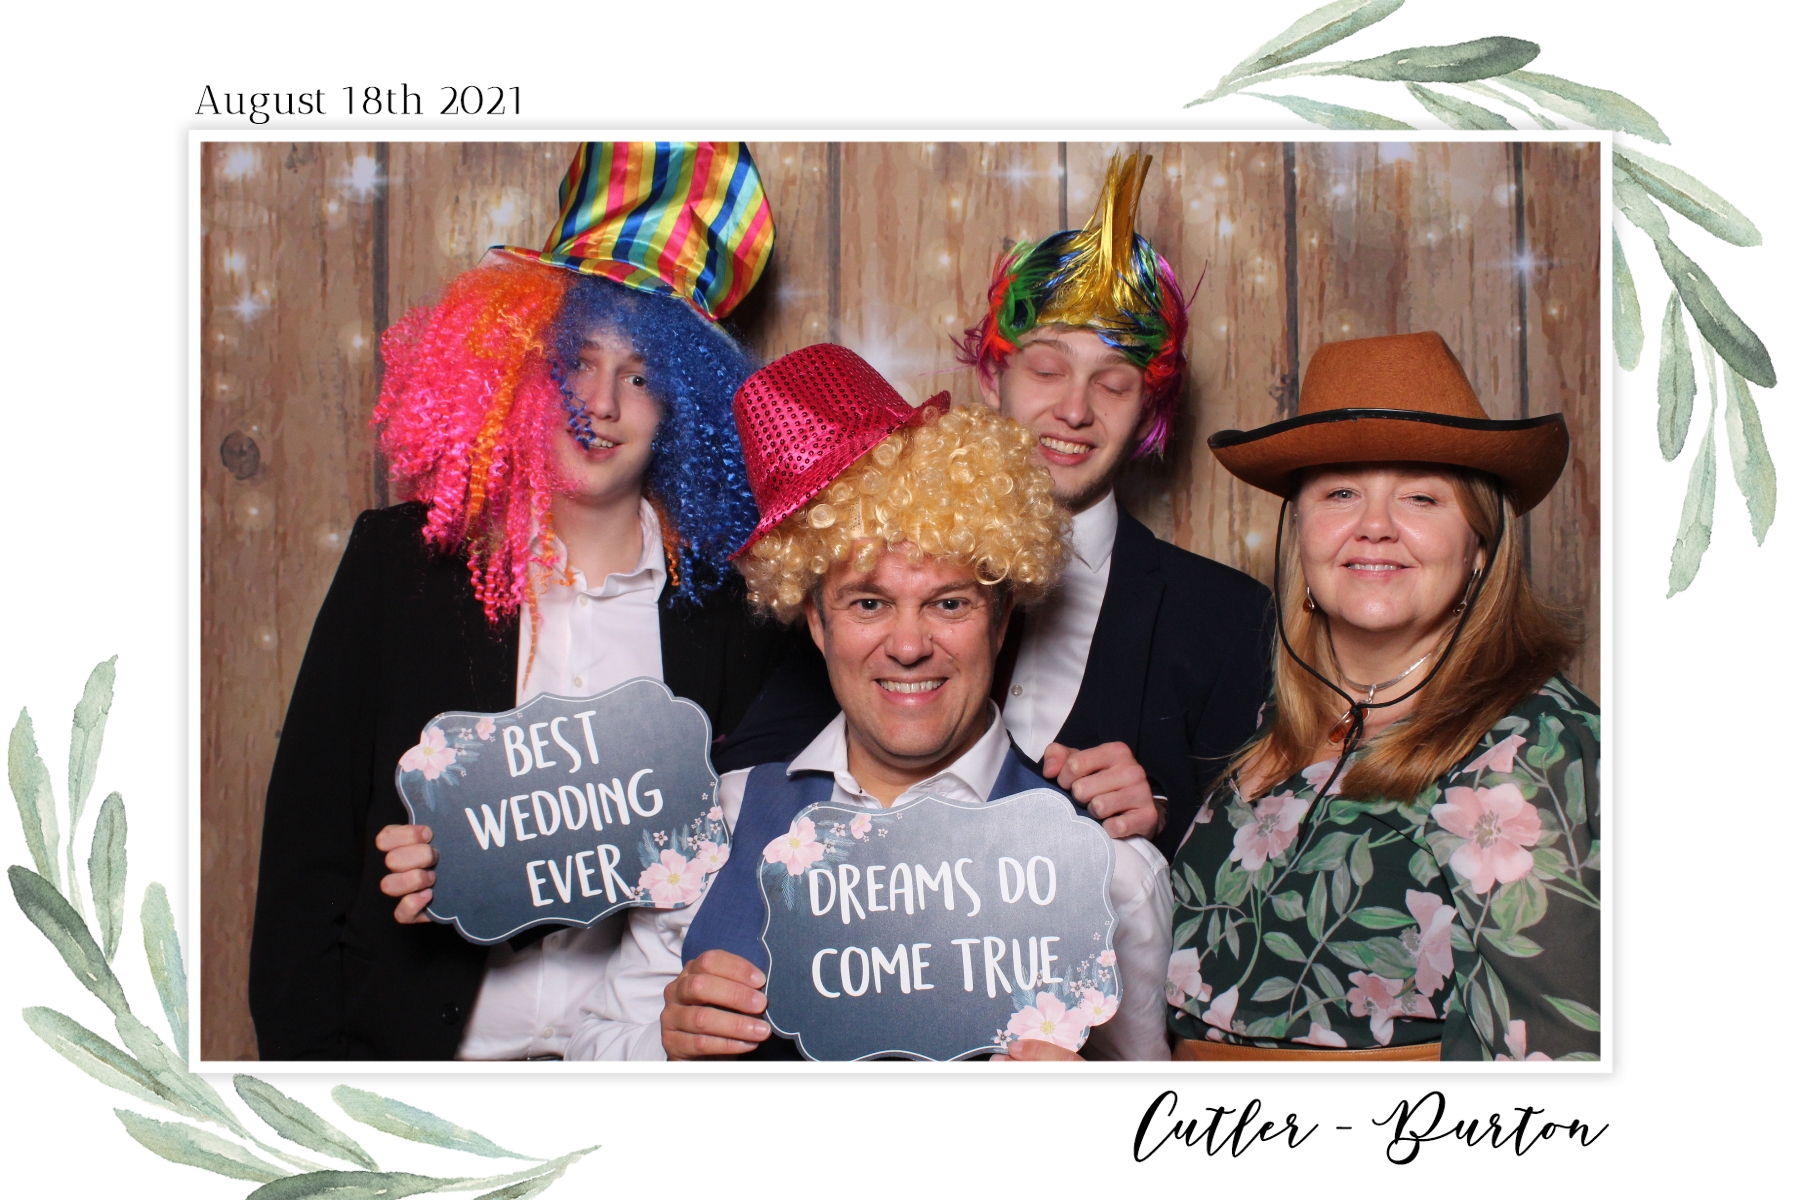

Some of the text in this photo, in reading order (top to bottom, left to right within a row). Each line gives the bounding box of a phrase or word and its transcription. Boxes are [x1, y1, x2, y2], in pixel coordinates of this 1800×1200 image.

[502, 710, 600, 777] BEST
[465, 768, 664, 850] WEDDING
[526, 844, 633, 907] EVER
[808, 855, 1057, 925] DREAMS DO
[811, 935, 1064, 999] COME TRUE
